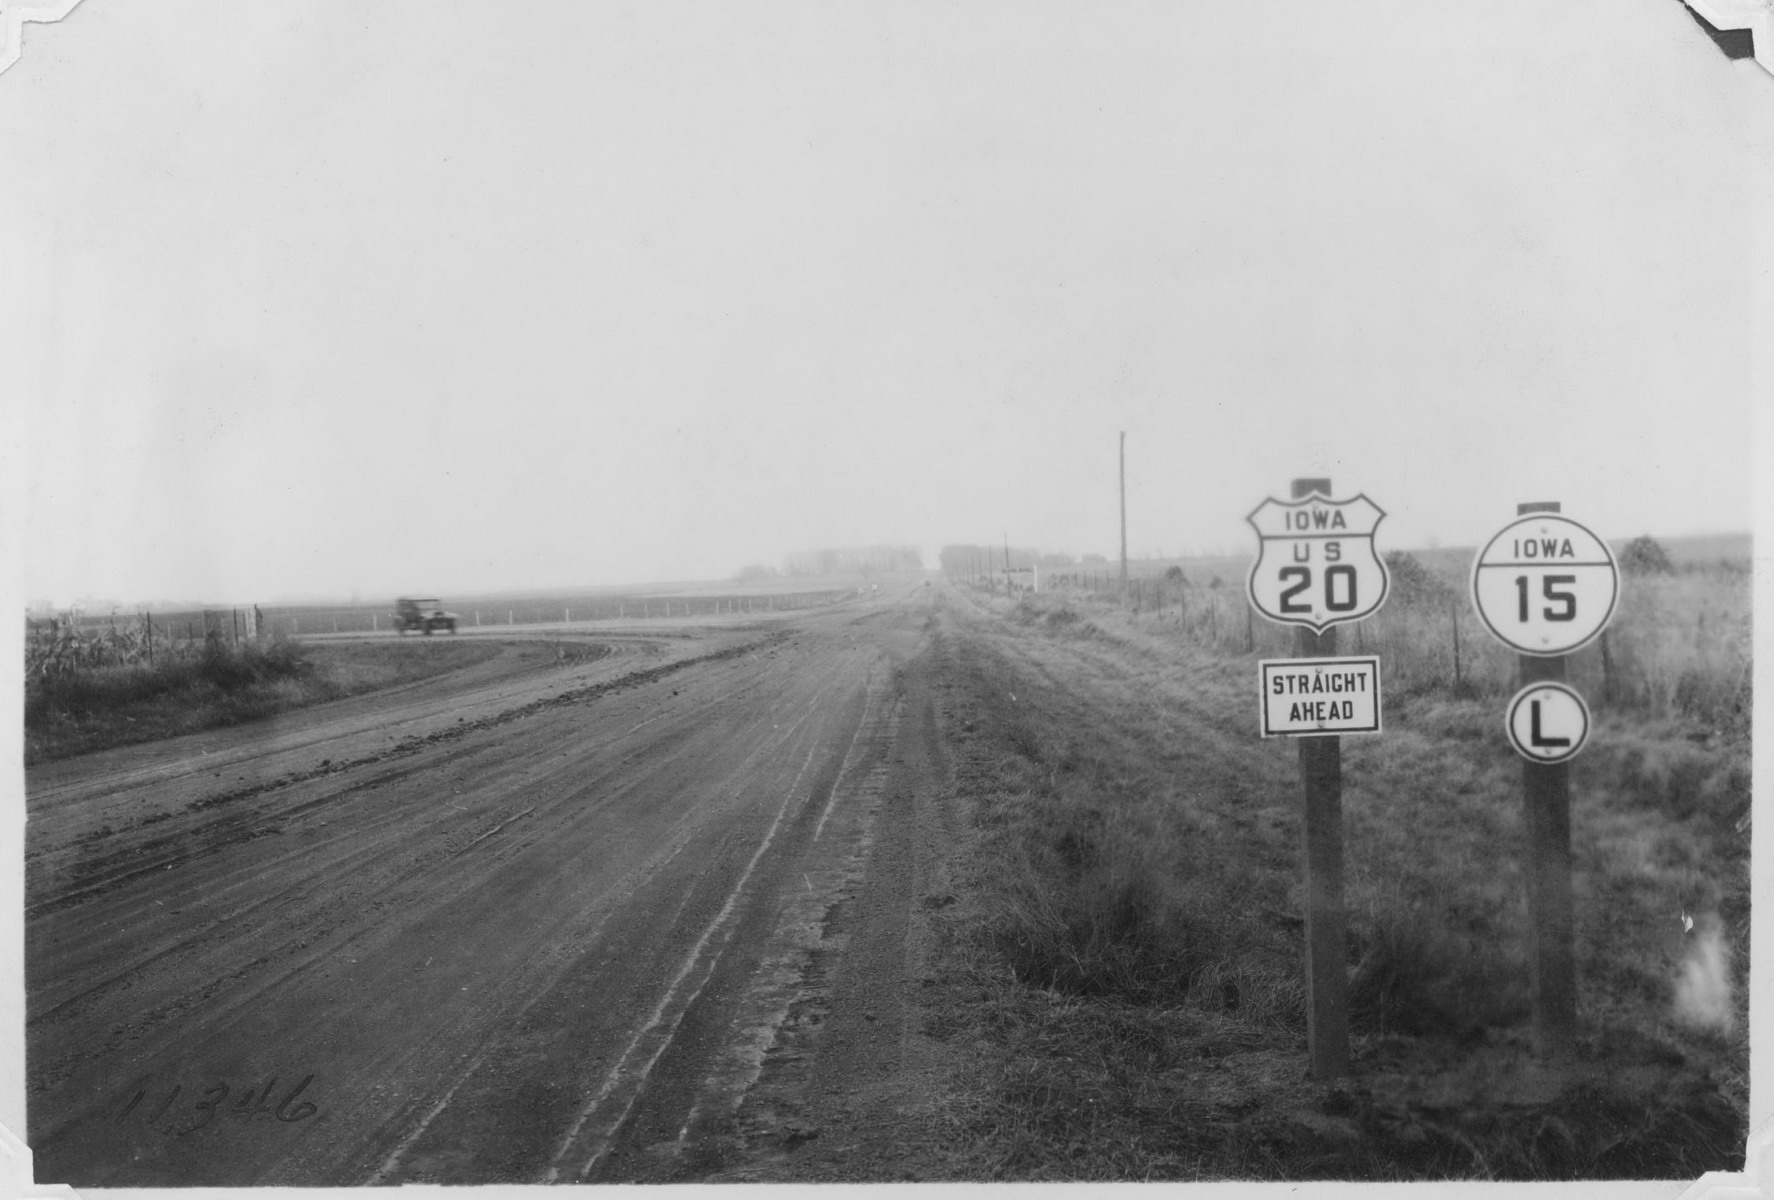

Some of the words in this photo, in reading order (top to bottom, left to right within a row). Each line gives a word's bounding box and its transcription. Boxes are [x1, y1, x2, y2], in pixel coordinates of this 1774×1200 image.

[1285, 509, 1347, 531] IOWA
[1513, 538, 1575, 559] IOWA
[1278, 565, 1358, 614] 20
[1515, 574, 1577, 623] 15
[1272, 672, 1368, 696] STRAIGHT
[1289, 700, 1354, 722] AHEAD
[1531, 699, 1571, 747] L
